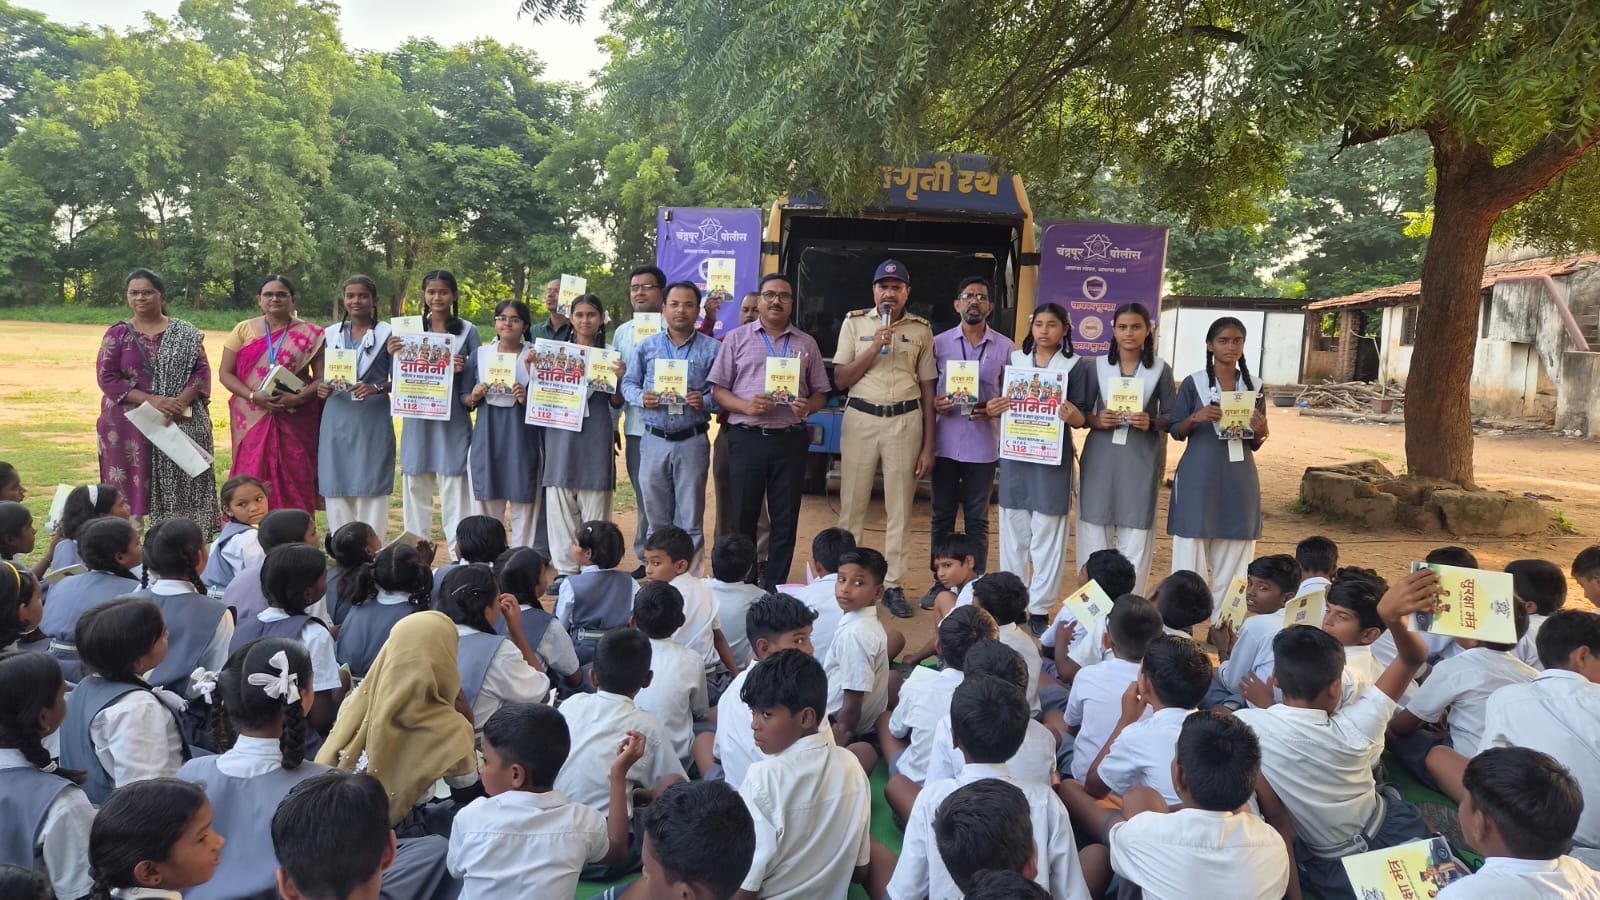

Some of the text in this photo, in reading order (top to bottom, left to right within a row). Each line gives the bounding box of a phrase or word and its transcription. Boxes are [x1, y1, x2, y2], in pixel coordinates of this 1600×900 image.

[958, 169, 1000, 196] रथ
[676, 229, 748, 244] चंद्रपूर पोलीस
[1056, 245, 1142, 261] चंद्रपूर पोलीस
[400, 358, 448, 375] दामिनी
[537, 368, 584, 385] दामिनी
[1009, 397, 1058, 415] दामिनी
[537, 411, 552, 419] 112
[1012, 444, 1027, 452] 112
[1460, 579, 1478, 630] सुरक्षा मंत्र
[1387, 858, 1404, 882] मंत्र
